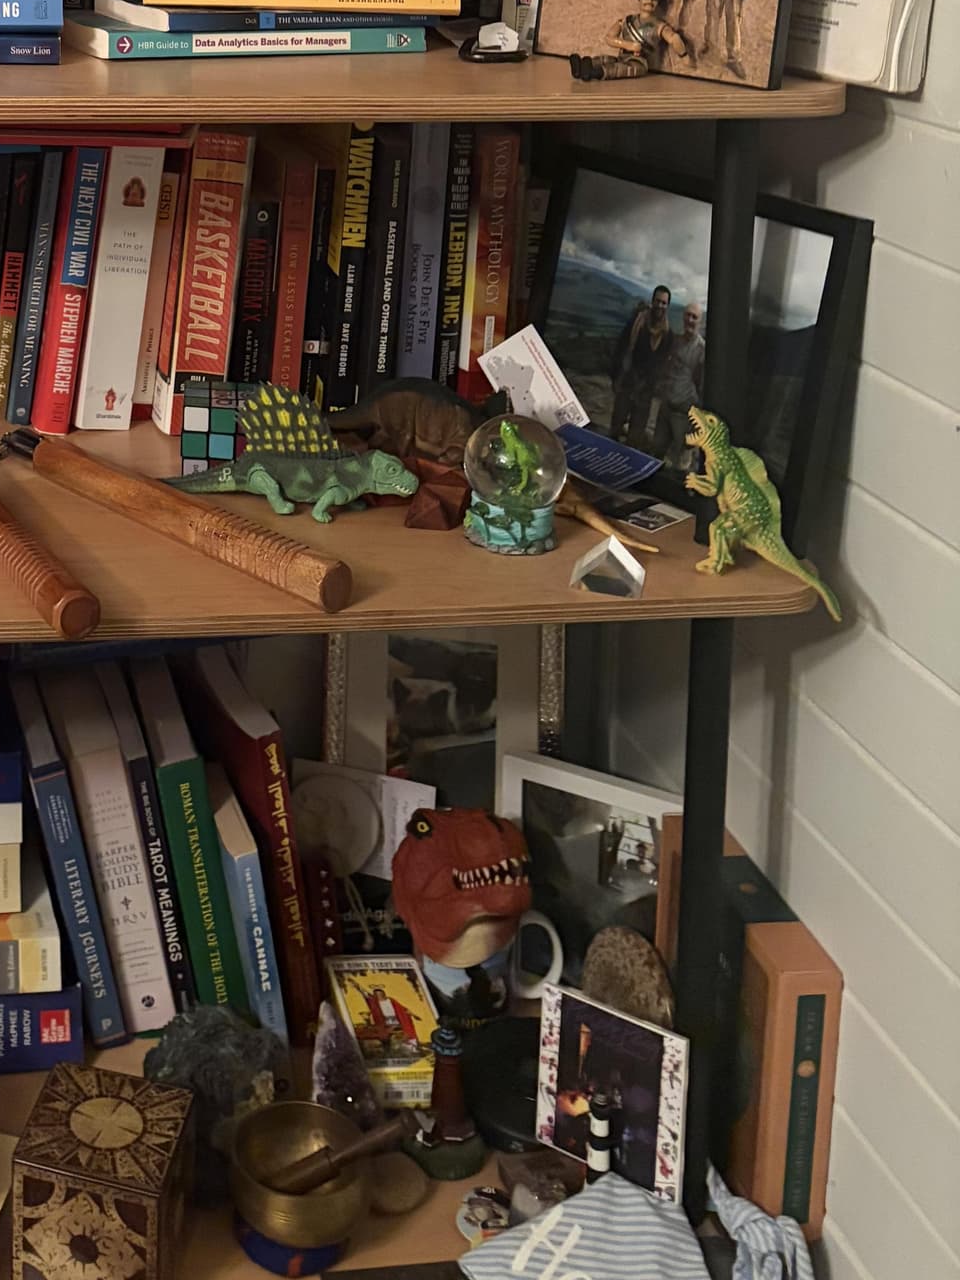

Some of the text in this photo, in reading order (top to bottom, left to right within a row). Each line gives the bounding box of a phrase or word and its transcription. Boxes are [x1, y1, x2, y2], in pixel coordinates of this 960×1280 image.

[195, 36, 347, 48] Data Analytics Basics for Managers
[342, 137, 374, 248] WATCHMEN
[185, 191, 234, 362] BASKETBALL
[64, 859, 107, 1000] LITERARY JOURNEYS
[148, 839, 182, 962] TAROT MEANINGS
